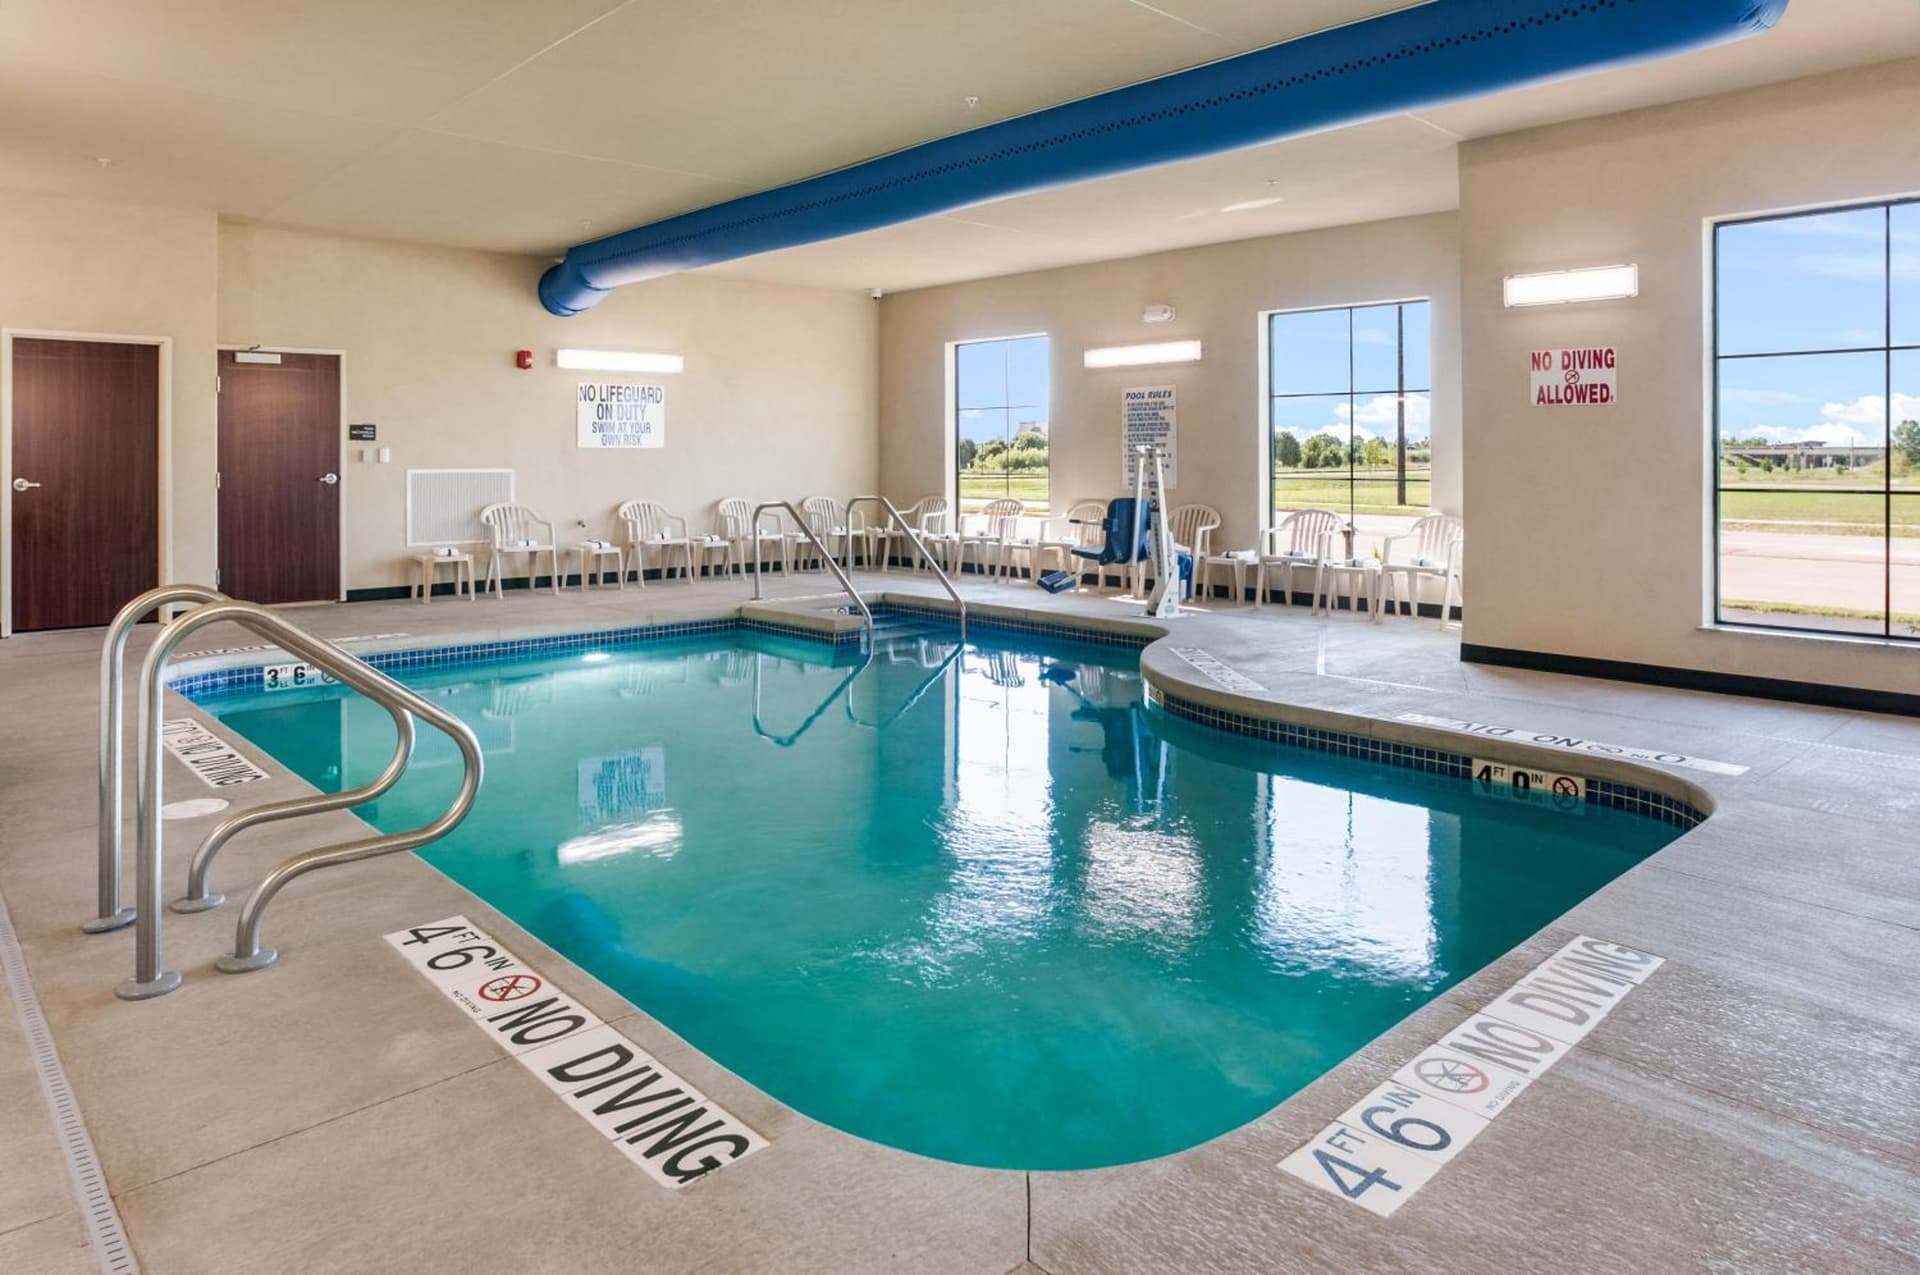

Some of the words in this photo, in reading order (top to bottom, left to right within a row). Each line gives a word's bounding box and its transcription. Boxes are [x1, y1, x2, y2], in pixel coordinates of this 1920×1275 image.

[1531, 351, 1552, 371] NO
[1561, 349, 1615, 370] DIVING
[580, 385, 596, 402] NO
[600, 385, 663, 403] LIFEGUARD
[1126, 391, 1145, 400] POOL
[1148, 390, 1172, 399] RULES
[597, 403, 612, 420] ON
[617, 404, 647, 420] DUTY
[592, 421, 615, 433] SWIM
[618, 422, 628, 433] AT
[630, 422, 651, 433] YOUR
[601, 434, 620, 446] OWN
[1533, 735, 1582, 747] NO
[1493, 766, 1505, 777] FT
[1531, 772, 1544, 784] IN
[1448, 1021, 1555, 1074] NO
[1507, 940, 1652, 1026] DIVING
[487, 997, 587, 1045] NO
[547, 1043, 750, 1184] DIVING
